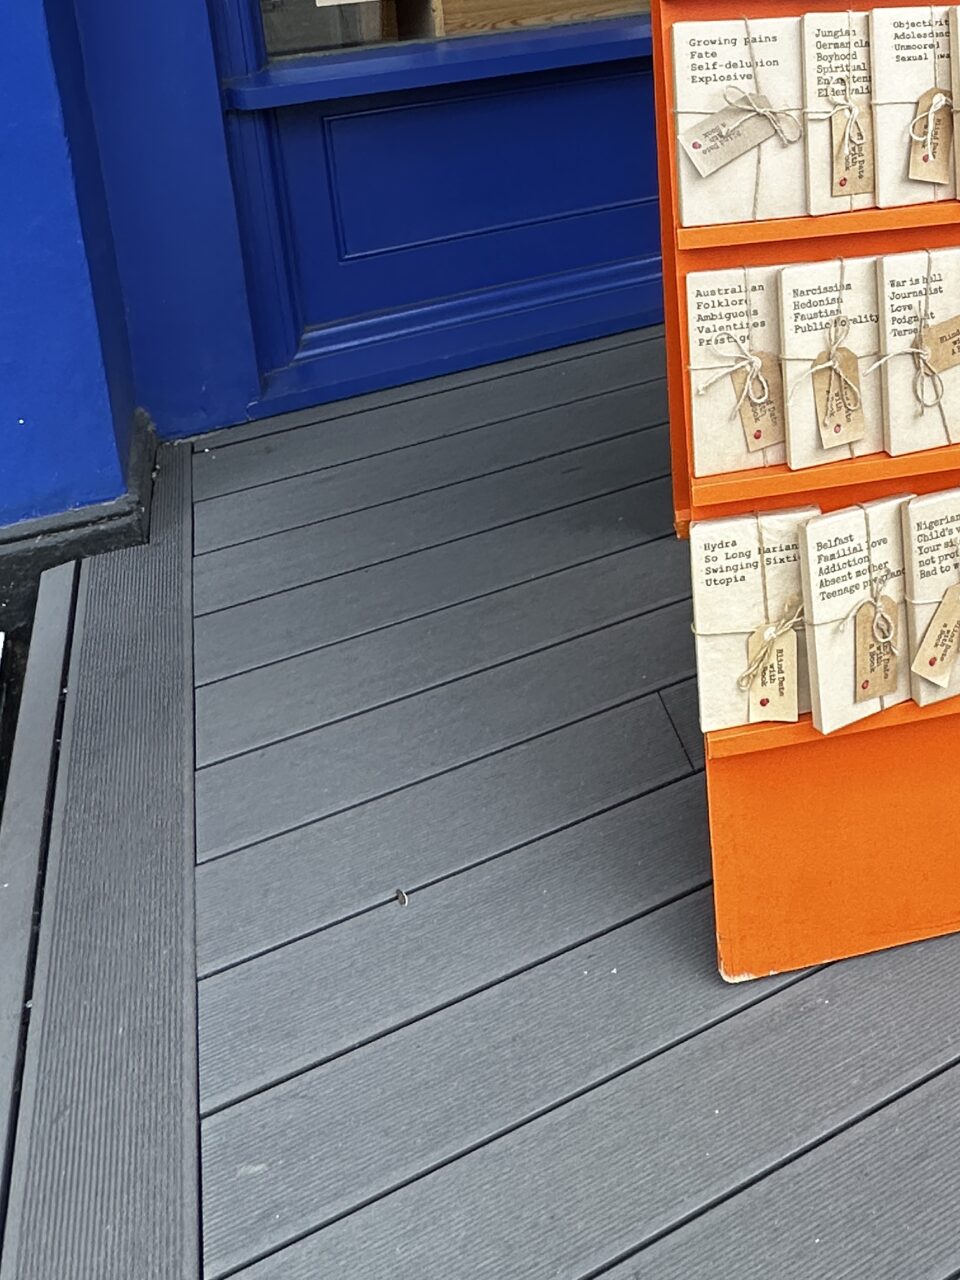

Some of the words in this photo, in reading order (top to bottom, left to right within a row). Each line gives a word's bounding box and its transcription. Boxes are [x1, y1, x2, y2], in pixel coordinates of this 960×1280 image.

[689, 37, 737, 47] Growing
[744, 35, 778, 45] pains
[816, 41, 850, 50] German
[690, 51, 717, 59] Fate
[816, 52, 857, 62] Boyhood
[896, 53, 928, 62] Sexual
[816, 63, 867, 75] Spiritual
[691, 73, 753, 84] Explosive
[890, 279, 907, 288] War
[909, 277, 919, 286] is
[793, 283, 852, 297] Narcissism
[890, 286, 943, 300] Journalist
[891, 303, 913, 313] Love
[794, 308, 842, 322] Faustian
[794, 322, 831, 333] Public
[917, 527, 954, 543] Child's
[704, 539, 737, 551] Hydra
[816, 533, 855, 552] Belfast
[817, 544, 863, 564] Familial
[917, 544, 942, 556] Your
[704, 555, 718, 563] So
[725, 550, 752, 560] Long
[918, 555, 936, 567] not
[705, 560, 759, 575] Swinging
[819, 556, 870, 576] Addiction
[920, 569, 938, 579] Bad
[940, 565, 951, 573] to
[705, 575, 746, 587] Utopia
[819, 573, 853, 589] Absent
[819, 583, 861, 601] Teenage
[777, 677, 786, 697] Date
